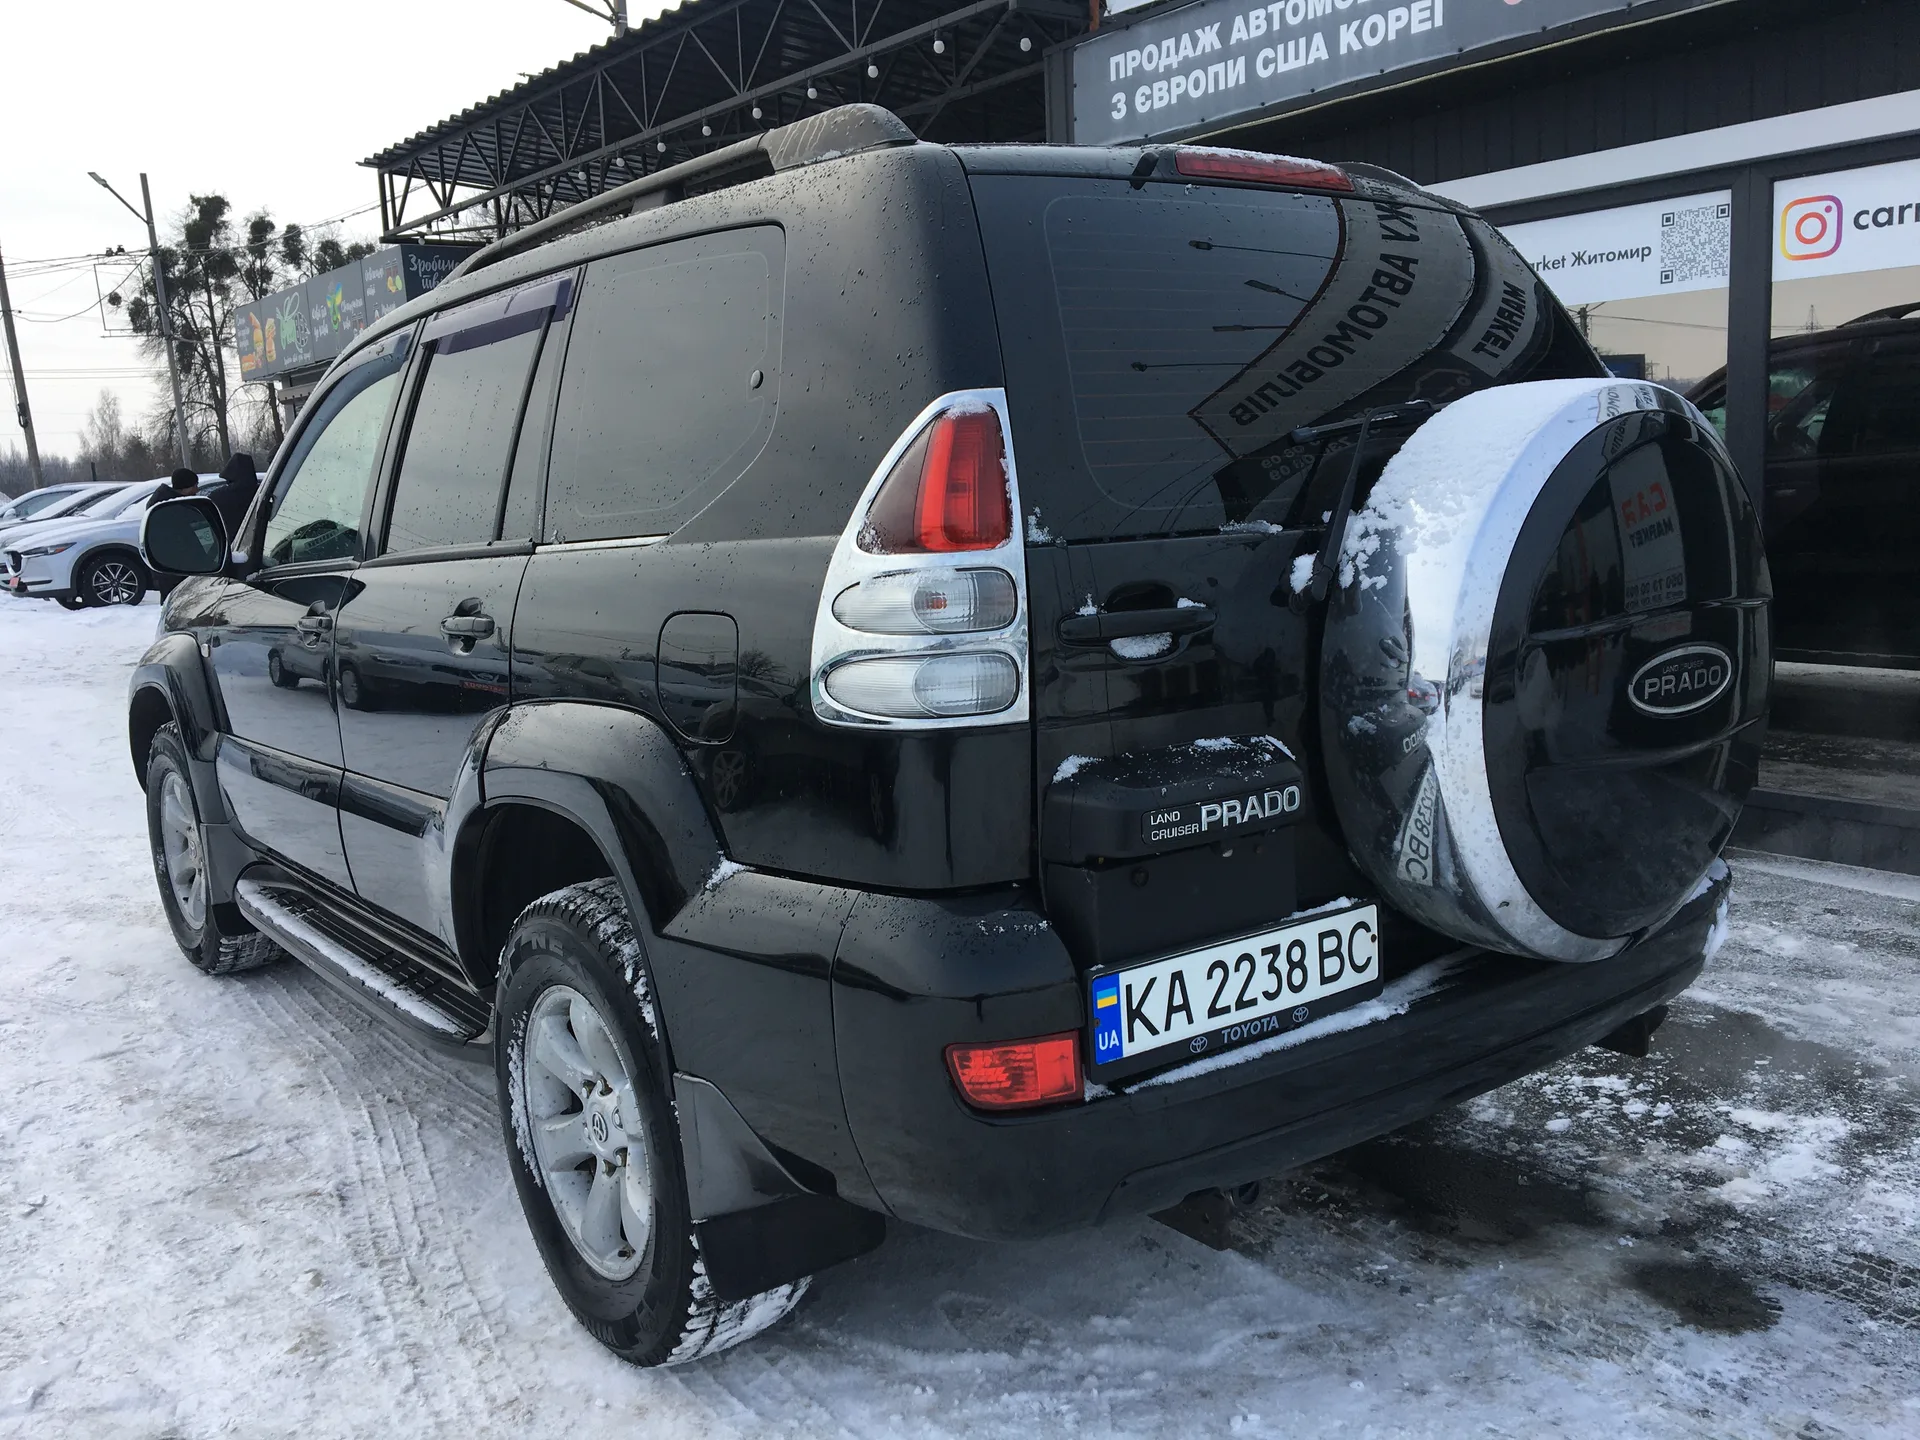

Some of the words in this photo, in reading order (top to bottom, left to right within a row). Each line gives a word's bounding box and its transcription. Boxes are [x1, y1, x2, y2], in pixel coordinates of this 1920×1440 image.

[1110, 22, 1222, 81] ПРОДАЖ
[1230, 0, 1367, 45] АВТОМ
[1111, 92, 1127, 120] З
[1135, 56, 1245, 113] ЄВРОПИ
[1256, 32, 1329, 78] США
[1571, 245, 1652, 267] Житомир
[1644, 665, 1722, 700] PRADO
[1150, 811, 1181, 826] LAND
[1151, 823, 1199, 841] CRUISER
[1201, 785, 1301, 832] PRADO
[1125, 970, 1194, 1043] KA
[1206, 939, 1309, 1019] 2238
[1318, 921, 1373, 986] BC
[1098, 1030, 1120, 1051] UA
[1221, 1015, 1280, 1044] TOYOTA
